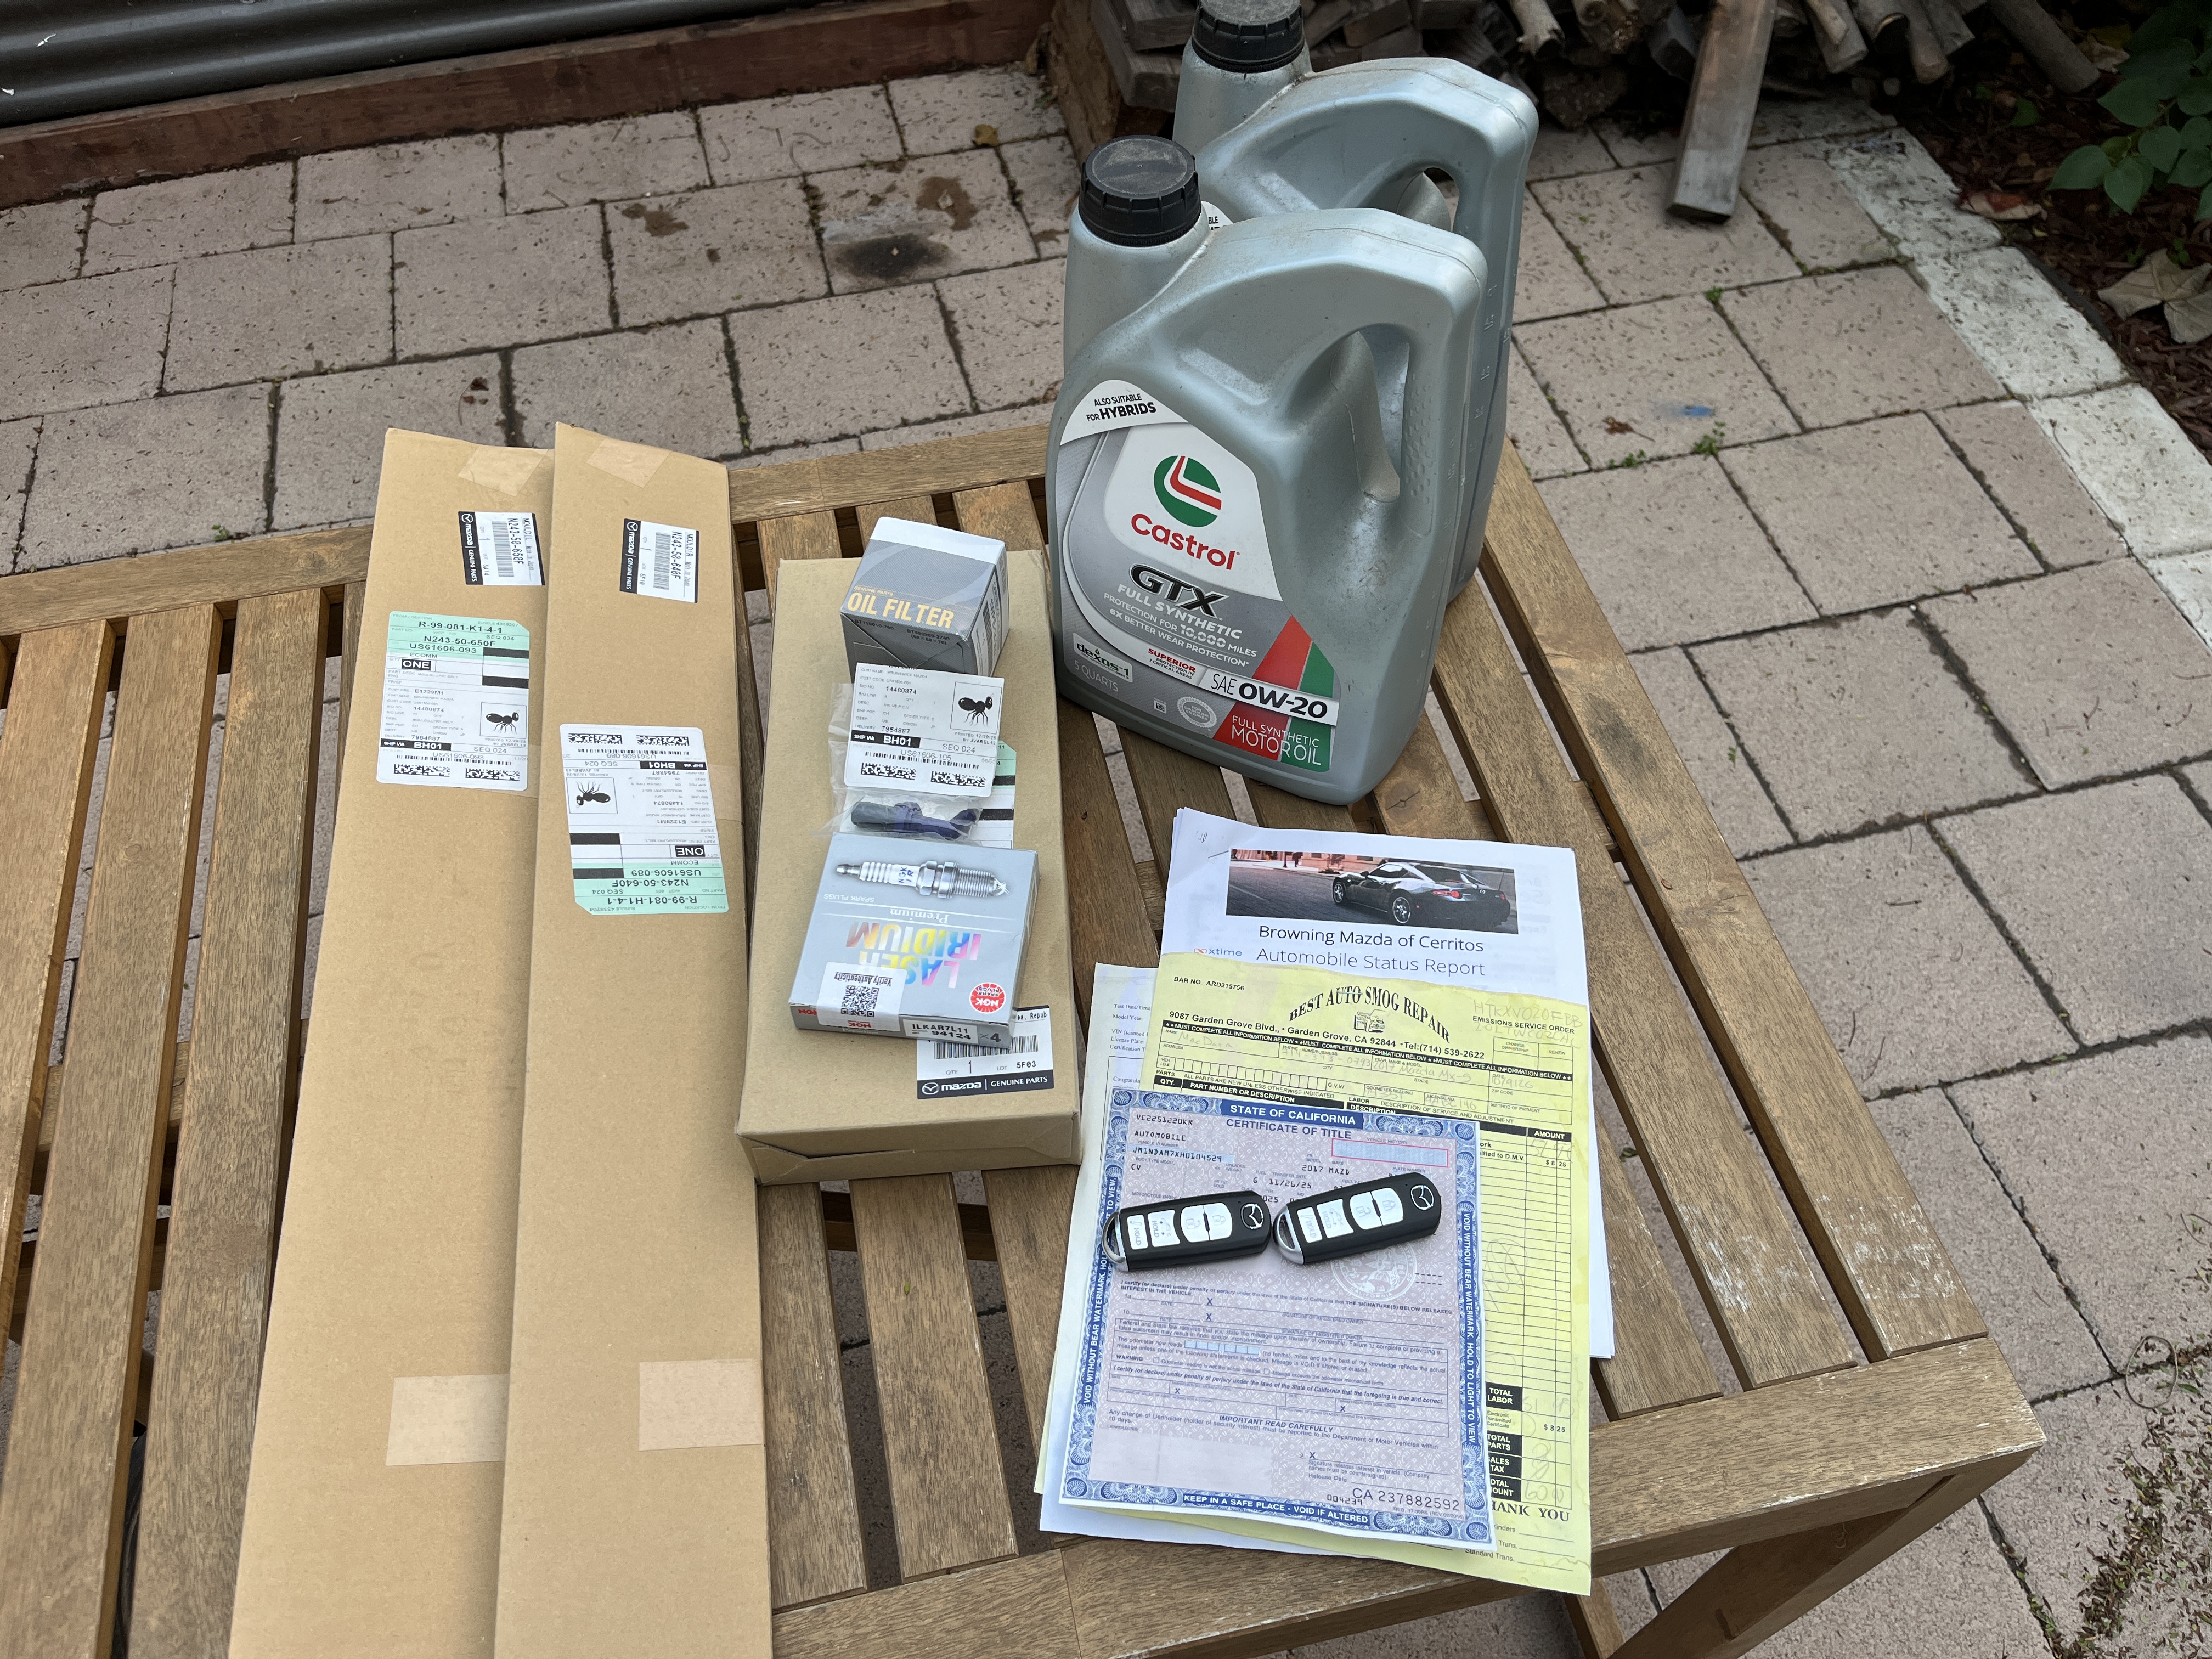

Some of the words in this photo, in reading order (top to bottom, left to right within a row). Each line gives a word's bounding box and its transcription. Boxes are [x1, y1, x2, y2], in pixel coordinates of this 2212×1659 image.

[1094, 397, 1111, 407] ALSO
[1111, 393, 1142, 404] SUITABLE
[1099, 402, 1156, 420] HYBRIDS
[508, 518, 524, 565] N243-50-650F
[1131, 514, 1235, 570] Castrol
[670, 531, 682, 579] N243-50-640F
[1129, 563, 1229, 619] GTX
[847, 592, 877, 615] OIL
[882, 597, 955, 629] FILTER
[1117, 584, 1152, 607] FULL
[1155, 601, 1243, 639] SYNTHETIC
[419, 621, 502, 634] R-99-081-K1-4-1
[1104, 592, 1157, 623] PROTECTION
[1159, 618, 1178, 632] FOR
[1180, 623, 1226, 649] 10,000
[1228, 643, 1257, 657] MILES
[1109, 608, 1122, 619] 6X
[1124, 616, 1155, 636] BETTER
[1157, 630, 1184, 649] WEAR
[410, 643, 477, 653] US61606-093
[424, 635, 496, 647] N243-50-650F
[403, 660, 430, 669] ONE
[1148, 648, 1195, 673] SUPERIOR
[1156, 658, 1184, 672] PROTECTION
[1074, 660, 1080, 670] 5
[1081, 664, 1119, 692] QUARTS
[1153, 660, 1175, 673] CRITICAL
[1176, 670, 1193, 679] AREAS
[885, 686, 917, 695] 14480874
[1210, 673, 1236, 696] SAE
[1239, 682, 1328, 718] 0W-20
[882, 726, 910, 734] 7954887
[1232, 715, 1260, 732] FULL
[1260, 724, 1319, 748] SYNTHETIC
[414, 742, 442, 750] BH01
[883, 735, 911, 746] BH01
[942, 743, 959, 752] SEQ
[961, 746, 975, 754] 024
[1232, 725, 1290, 758] MOTOR
[1294, 744, 1322, 766] OIL
[901, 749, 952, 761] US61606-105
[898, 866, 908, 883] NGK
[612, 879, 689, 887] N243-50-640F
[607, 896, 697, 904] R-99-081-H1-4-1
[850, 895, 875, 903] SPARK
[890, 908, 950, 924] Premium
[845, 921, 981, 961] IRIDIUM
[1260, 926, 1335, 945] Browning
[1339, 930, 1392, 947] Mazda
[1398, 934, 1414, 947] of
[1419, 935, 1484, 952] Cerritos
[1208, 947, 1242, 957] xtime
[1256, 947, 1358, 967] Automobile
[1364, 955, 1419, 971] Status
[1425, 958, 1486, 977] Report
[833, 972, 872, 985] Authenticity
[873, 976, 893, 987] Verify
[1206, 980, 1244, 991] ARD215756
[975, 997, 999, 1007] NGK
[1289, 992, 1323, 1022] BEST
[1325, 985, 1362, 1006] AUTO
[1364, 986, 1400, 1011] SMOG
[1403, 996, 1450, 1043] REPAIR
[1472, 1015, 1513, 1026] EMISSIONS
[1549, 1025, 1575, 1034] ORDER
[932, 1030, 972, 1040] 94124
[1169, 1011, 1189, 1020] 9087
[1192, 1014, 1224, 1024] Garden
[1226, 1019, 1253, 1029] Grove
[1287, 1026, 1320, 1037] Garden
[1322, 1031, 1352, 1042] Grove,
[1354, 1035, 1367, 1043] CA
[1370, 1037, 1396, 1047] 92844
[1444, 1047, 1485, 1059] 539-2622
[968, 1060, 972, 1074] 1
[941, 1081, 982, 1091] mazda
[990, 1078, 1024, 1088] GENUINE
[1209, 1084, 1238, 1094] NUMBER
[1250, 1091, 1295, 1103] DESCRIPTION
[1230, 1104, 1266, 1116] STATE
[1269, 1109, 1285, 1118] OF
[1288, 1110, 1356, 1125] CALIFORNIA
[1135, 1130, 1186, 1141] AUTOMOBILE
[1226, 1119, 1299, 1133] CERTIFICATE
[1302, 1126, 1317, 1135] OF
[1321, 1128, 1352, 1139] TITLE
[1534, 1130, 1565, 1139] AMOUNT
[1302, 1165, 1323, 1173] 2017
[1269, 1178, 1312, 1189] 11/26/25
[1466, 1368, 1475, 1380] TO
[1489, 1387, 1513, 1397] TOTAL
[1487, 1395, 1513, 1404] LABOR
[1468, 1409, 1475, 1421] TO
[1219, 1415, 1263, 1426] IMPORTANT
[1289, 1423, 1334, 1433] CAREFULLY
[1490, 1479, 1510, 1488] OTAL
[1327, 1494, 1363, 1506] 004239
[1352, 1488, 1373, 1500] CA
[1378, 1491, 1460, 1511] 237882592
[1230, 1499, 1254, 1507] SAFE
[1256, 1502, 1285, 1511] PLACE
[1294, 1506, 1315, 1515] VOID
[1328, 1513, 1368, 1523] ALTERED
[1540, 1507, 1570, 1522] YOU
